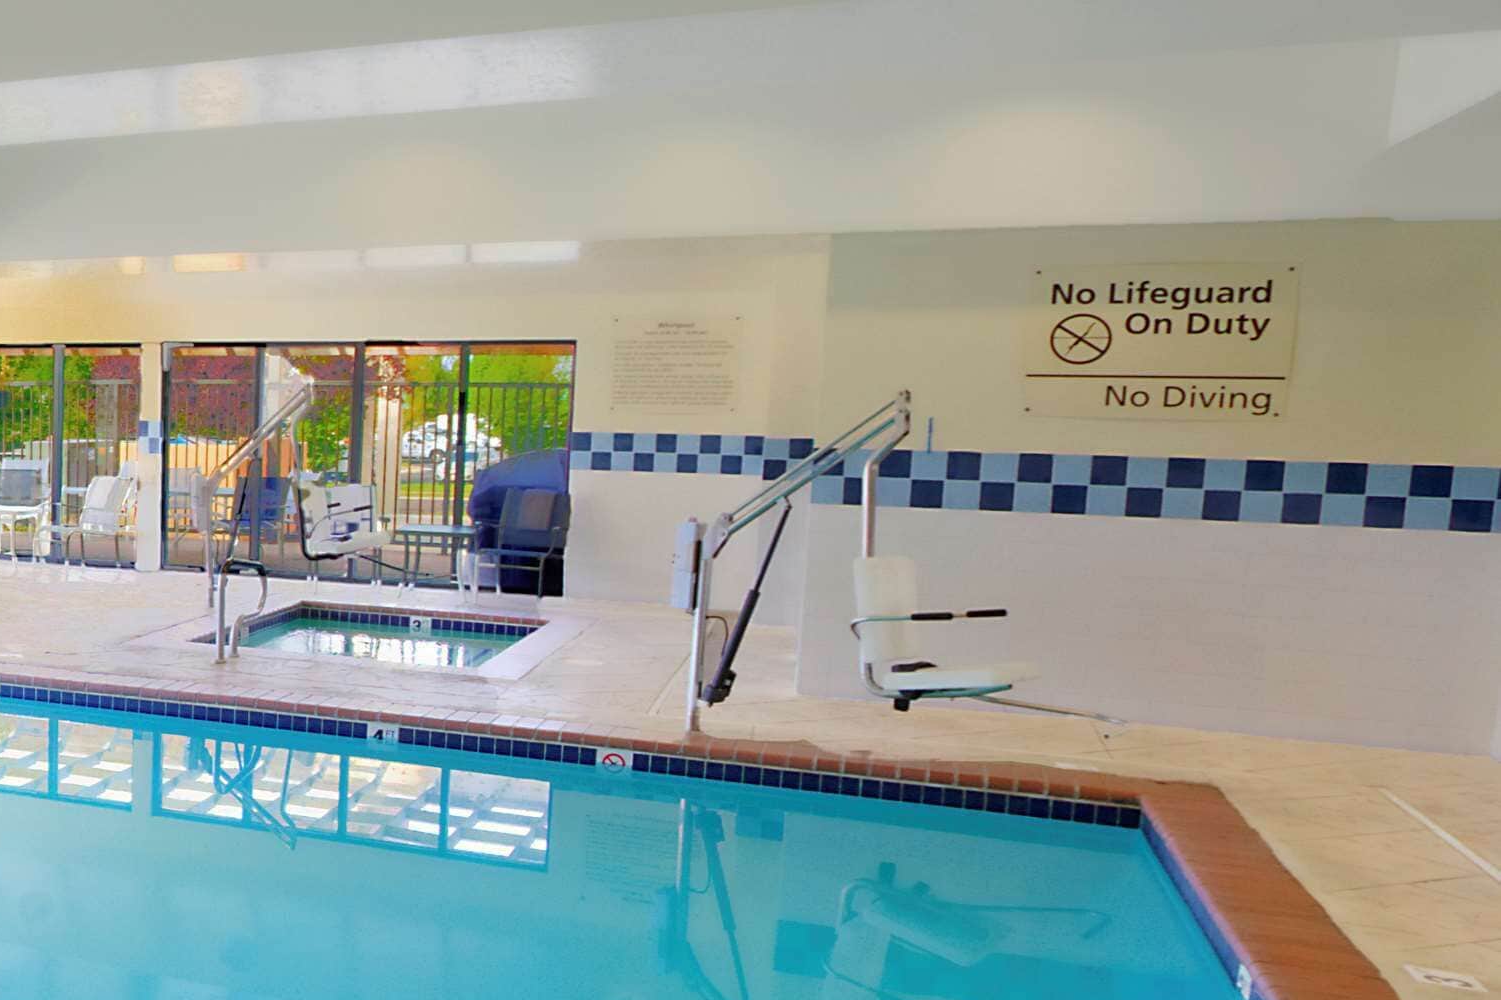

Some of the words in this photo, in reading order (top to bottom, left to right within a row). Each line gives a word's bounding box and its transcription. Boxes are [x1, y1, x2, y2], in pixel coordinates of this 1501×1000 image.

[1051, 283, 1096, 305] No
[1108, 279, 1274, 311] Lifeguard
[1124, 312, 1173, 335] On
[1186, 312, 1271, 342] Duty
[1104, 385, 1150, 407] No
[1162, 385, 1272, 416] Diving
